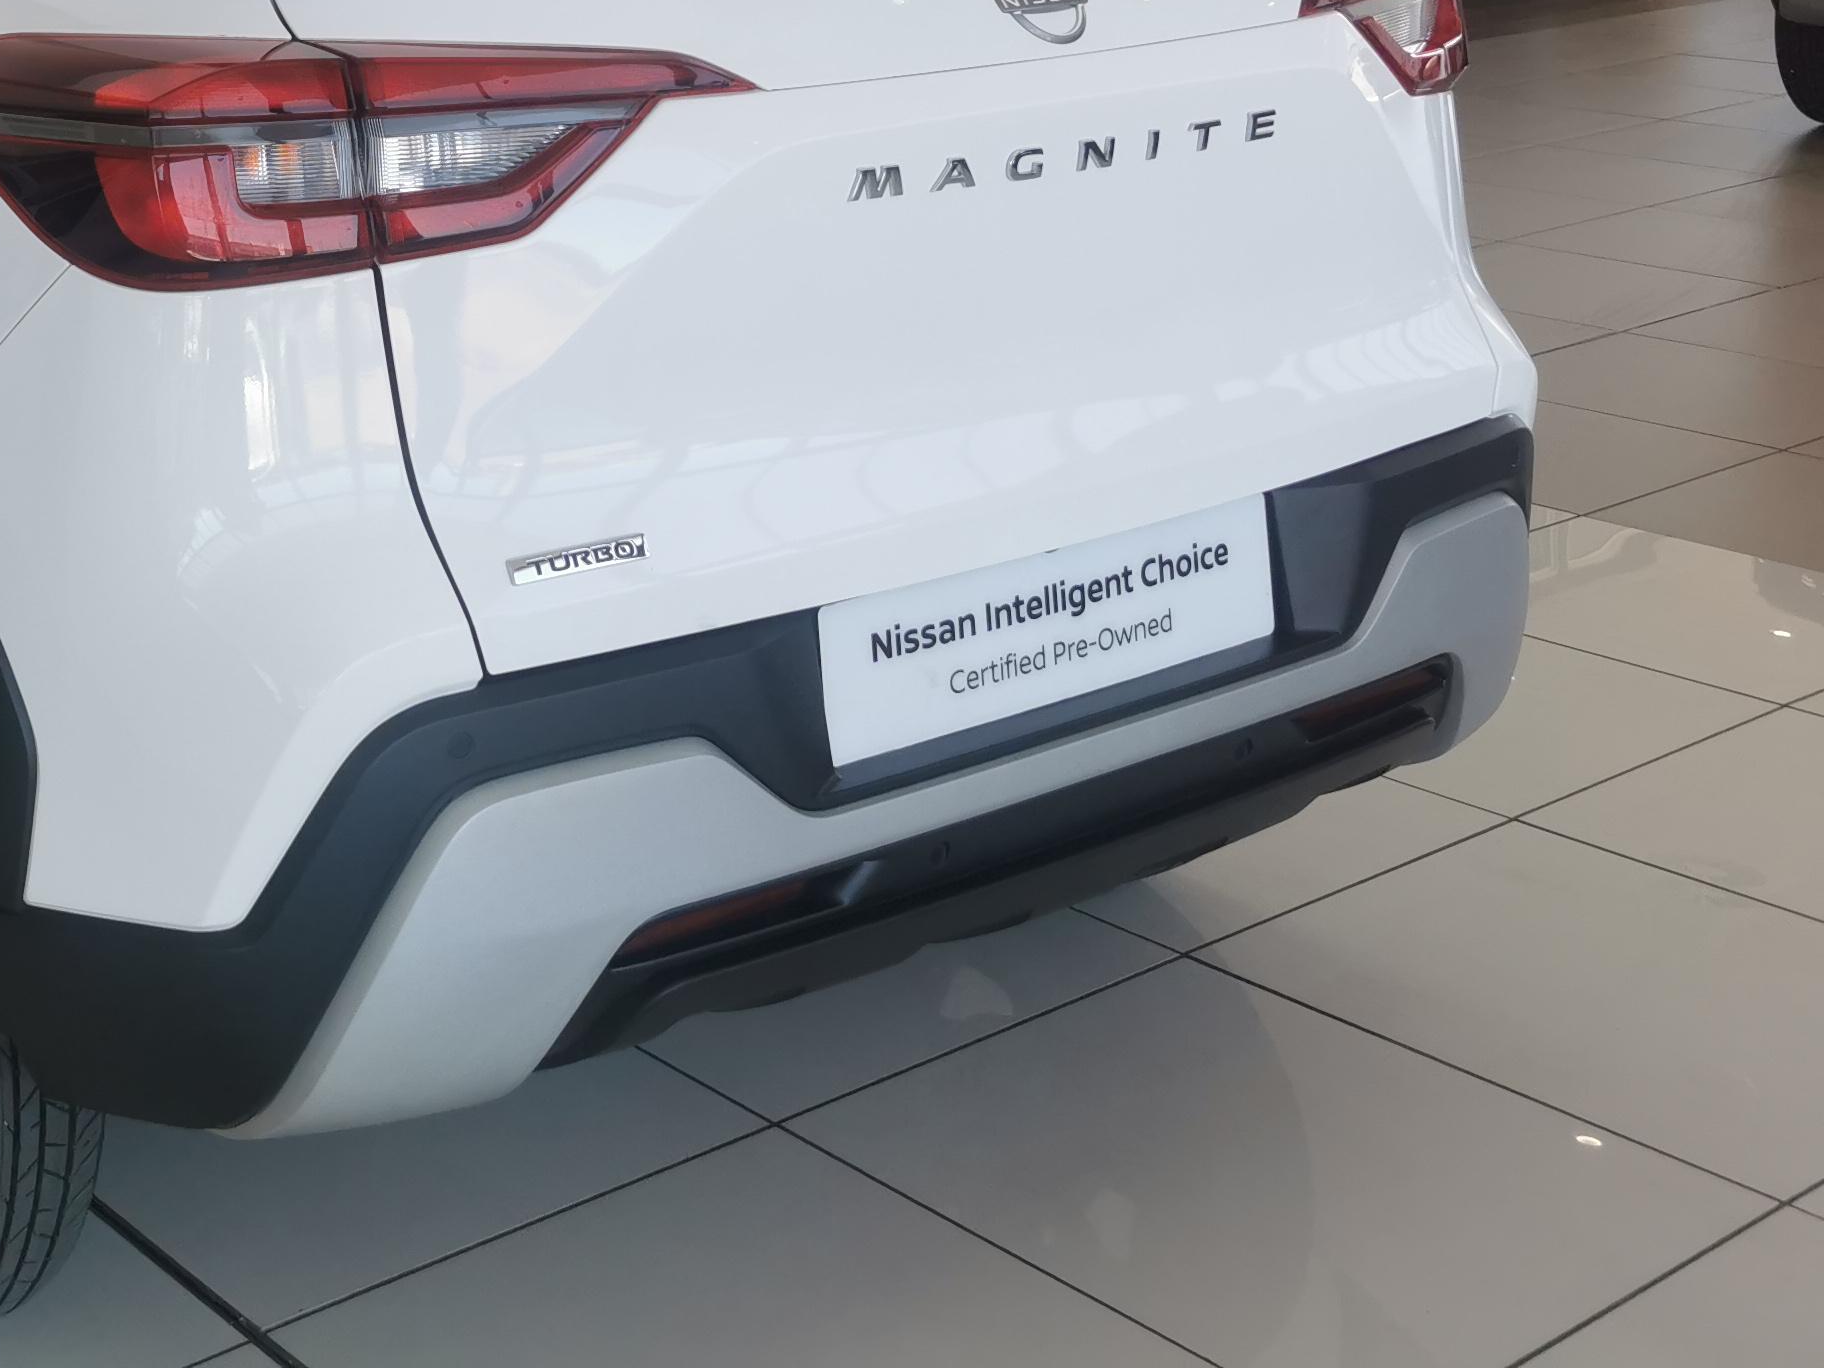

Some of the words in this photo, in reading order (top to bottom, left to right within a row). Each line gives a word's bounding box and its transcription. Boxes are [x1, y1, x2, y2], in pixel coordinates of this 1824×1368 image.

[847, 109, 1276, 202] MAGNITE
[526, 539, 635, 575] TURBO
[870, 612, 977, 662] Nissan
[985, 565, 1134, 632] Intelligent
[1140, 542, 1229, 587] Choice
[949, 645, 1046, 694] Certified
[1053, 607, 1173, 666] Pre-Owned
